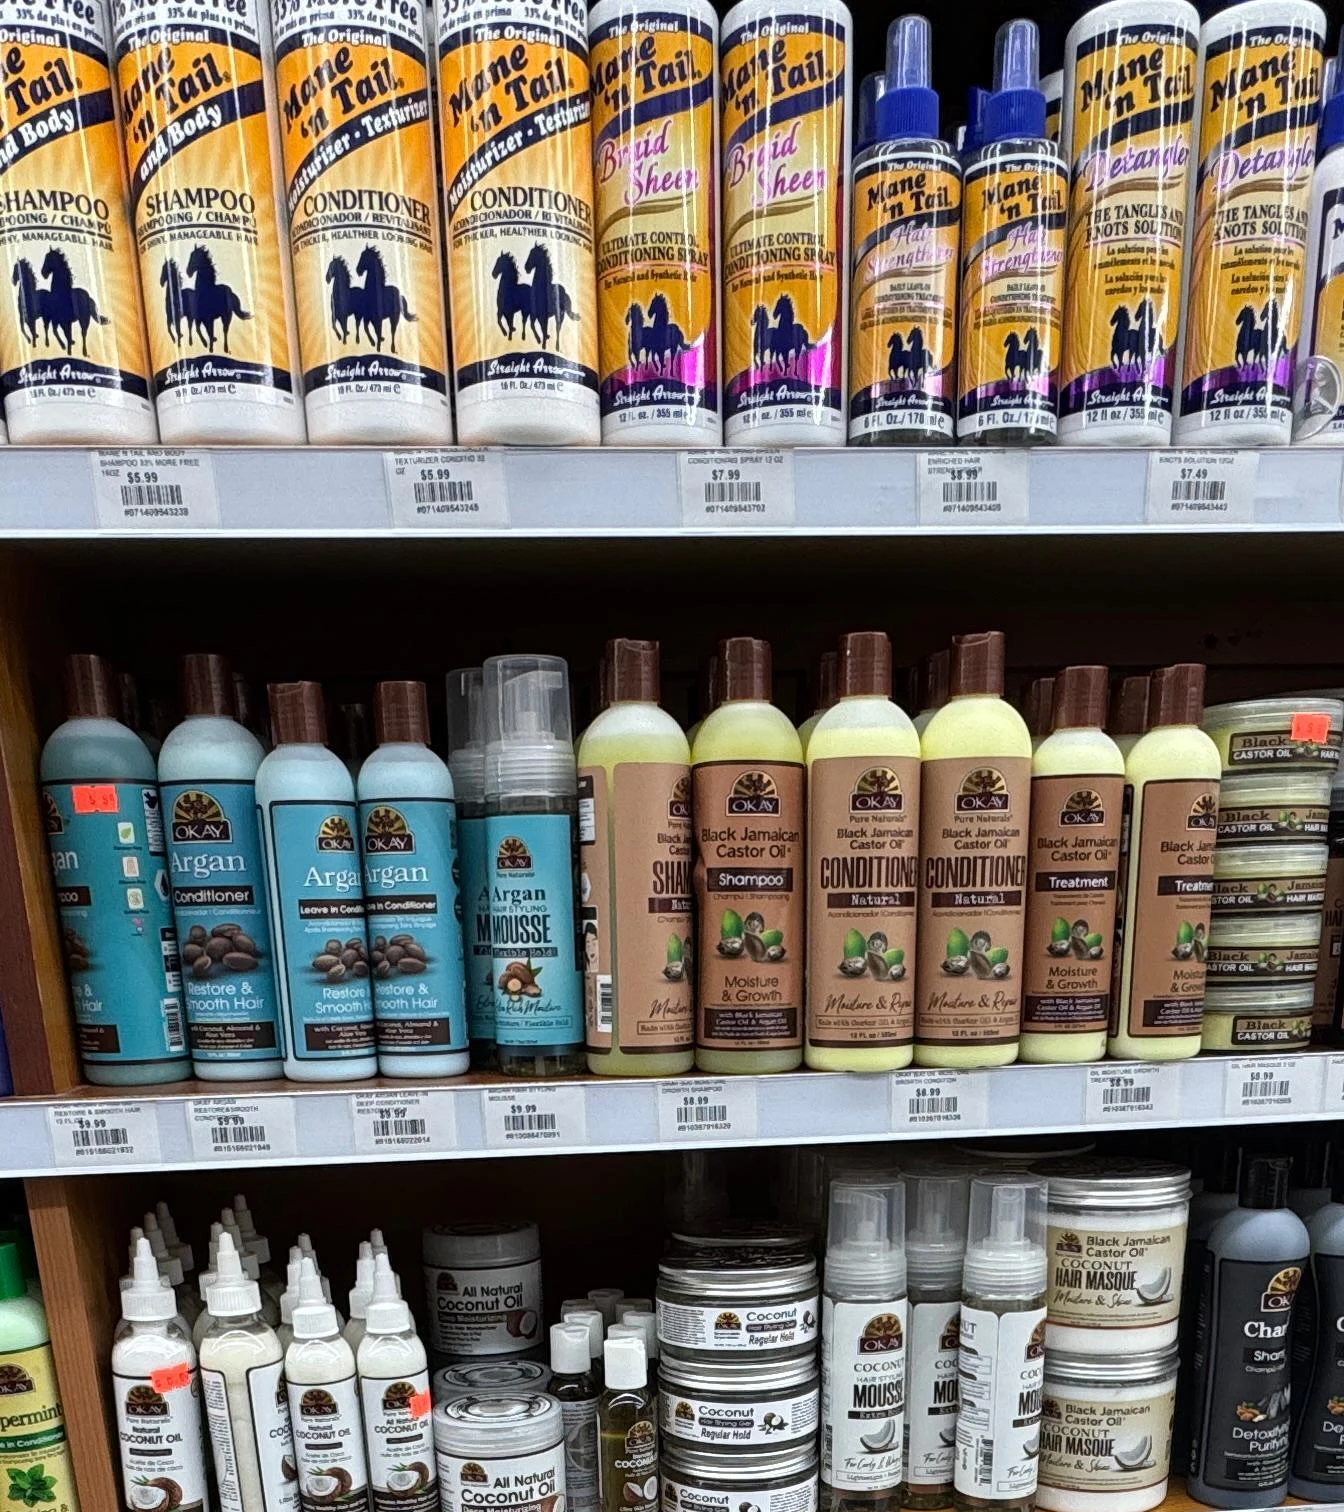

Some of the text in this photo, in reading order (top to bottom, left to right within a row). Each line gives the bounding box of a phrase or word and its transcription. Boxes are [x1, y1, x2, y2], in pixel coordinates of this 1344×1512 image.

[505, 30, 560, 46] Original
[449, 44, 529, 125] Mane
[1081, 48, 1164, 112] Mane
[286, 46, 353, 131] Mane
[506, 66, 569, 112] Tail
[23, 106, 74, 148] Body
[625, 162, 699, 203] Sheen
[146, 189, 255, 214] SHAMPOO
[304, 190, 430, 222] CONDITIONER
[471, 186, 591, 221] CONDITIONER
[127, 471, 157, 485] $5.99
[421, 469, 450, 481] $5.99
[712, 469, 741, 481] $7.99
[1181, 469, 1208, 480] $7.49
[731, 800, 778, 814] OKAY
[174, 824, 224, 841] OKAY
[702, 827, 799, 843] Black Jamaican
[716, 844, 786, 858] Castor Oil
[171, 851, 246, 877] Argan
[926, 858, 1025, 887] CONDITIONER
[719, 874, 784, 888] Shampoo
[1049, 876, 1109, 889] Treatment
[176, 890, 251, 905] Conditioner
[493, 888, 545, 907] Argan
[954, 893, 1005, 904] Natural
[493, 915, 551, 943] MOUSSE
[725, 976, 779, 988] Moisture
[736, 988, 782, 1003] Growth
[1087, 1236, 1171, 1246] Black Jamaican
[1086, 1248, 1145, 1258] Castor Oil
[1061, 1261, 1132, 1270] COCONUT
[1056, 1270, 1136, 1290] HAIR MASQUE
[699, 1406, 754, 1417] Coconut
[120, 1433, 182, 1444] COCONUT OIL
[701, 1429, 751, 1440] Regular Hold
[493, 1469, 555, 1489] All Natural
[461, 1480, 556, 1503] Coconut Oil
